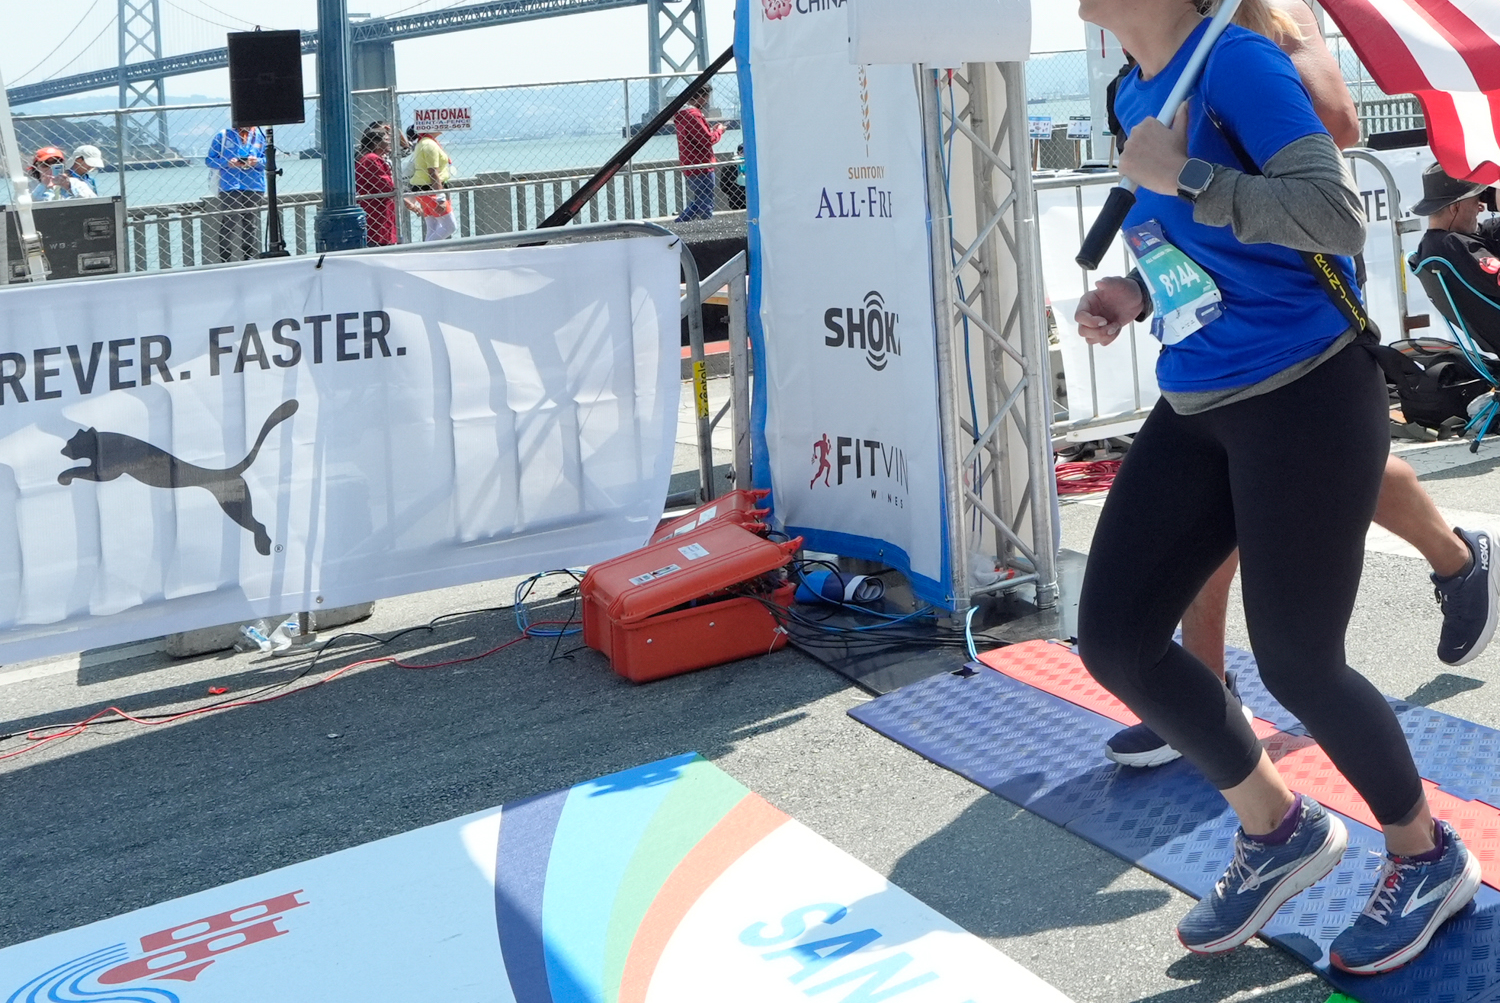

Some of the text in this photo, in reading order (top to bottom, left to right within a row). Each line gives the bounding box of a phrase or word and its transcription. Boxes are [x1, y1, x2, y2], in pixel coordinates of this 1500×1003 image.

[415, 108, 471, 121] NATIONAL
[1158, 262, 1201, 298] 8144
[824, 307, 901, 356] SHOK
[0, 310, 407, 406] REVER. FASTER.
[1479, 538, 1489, 571] HOKA
[738, 902, 941, 1003] SAN
